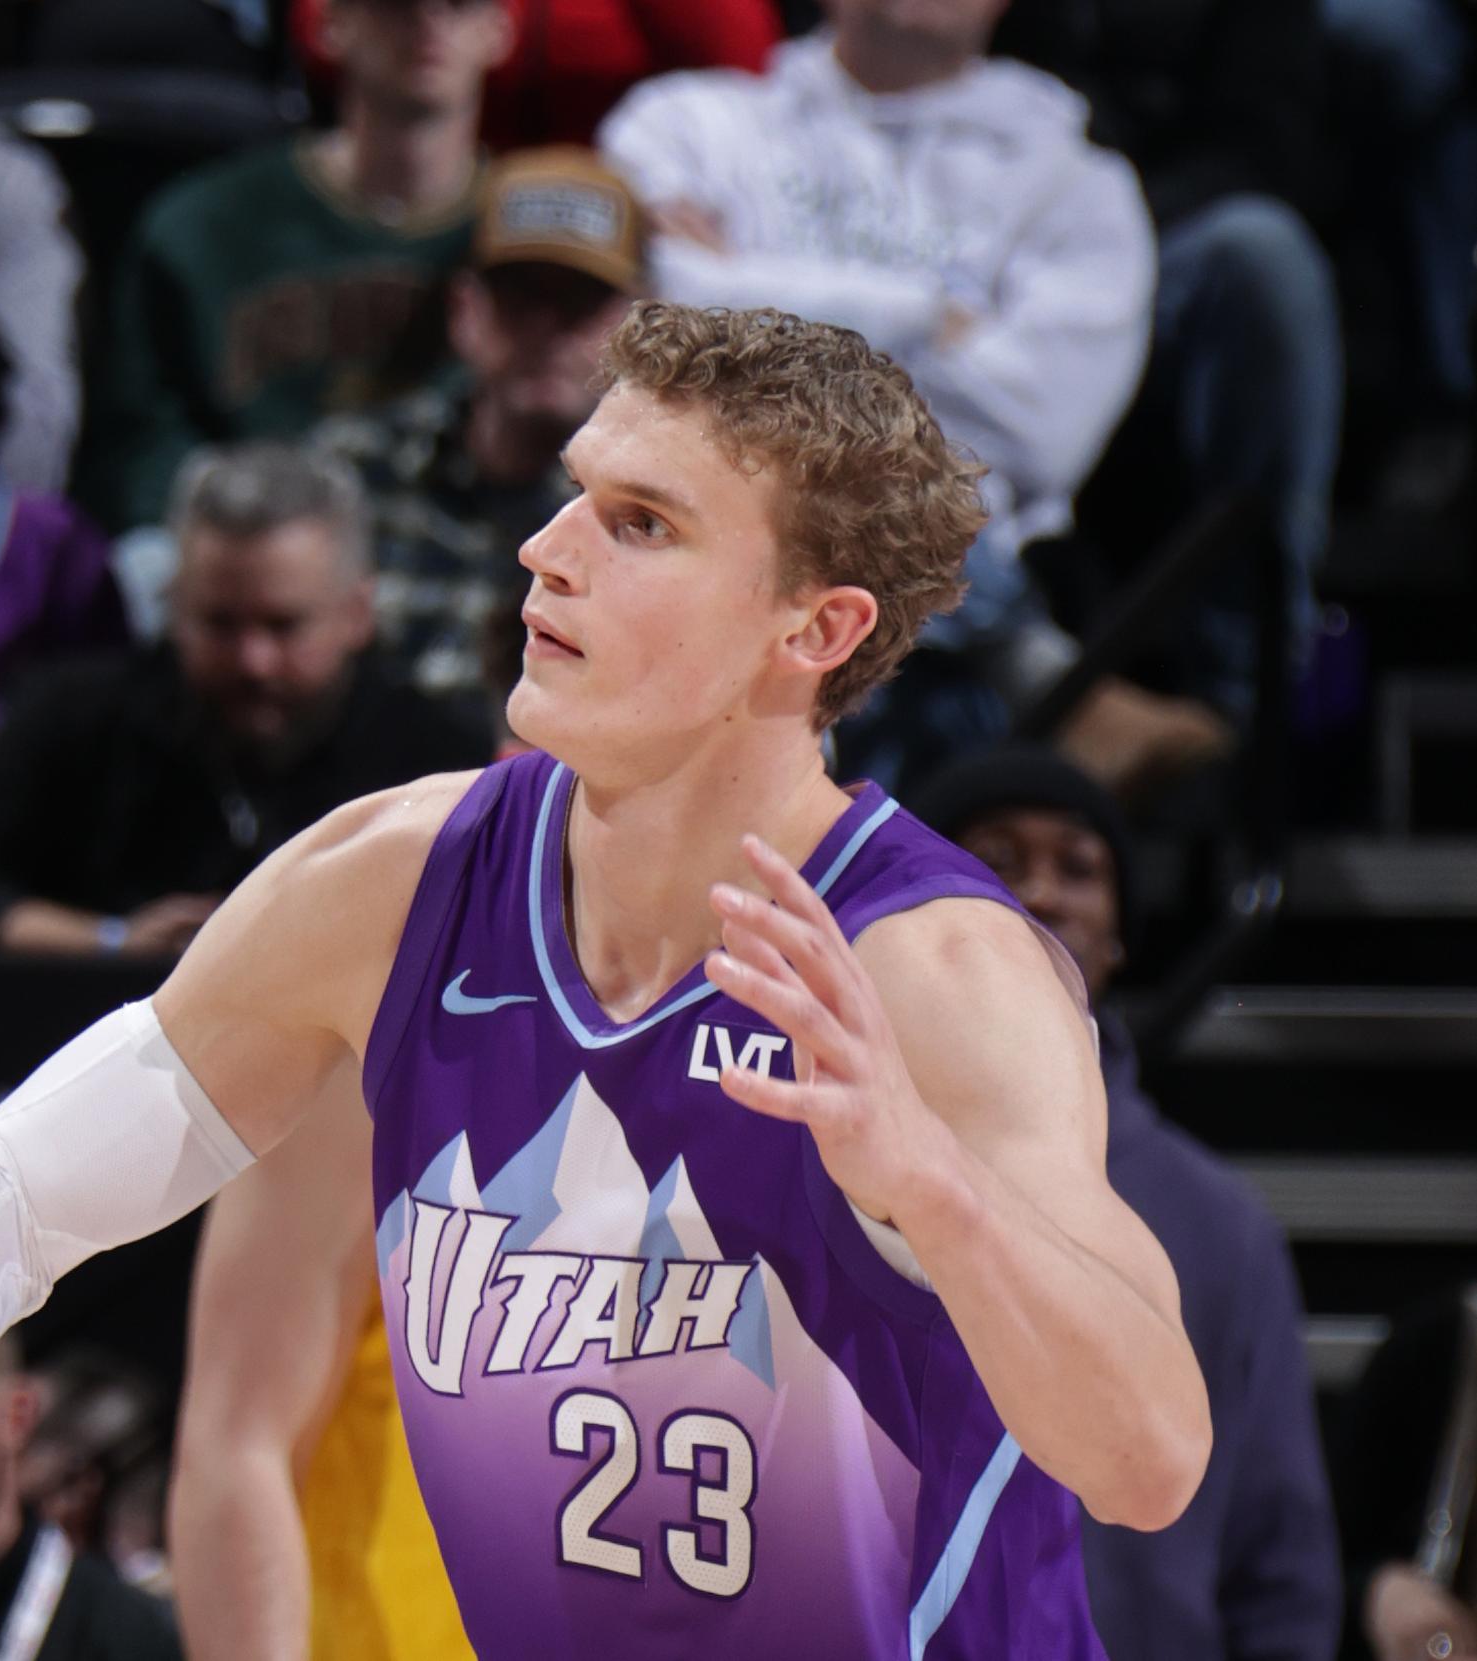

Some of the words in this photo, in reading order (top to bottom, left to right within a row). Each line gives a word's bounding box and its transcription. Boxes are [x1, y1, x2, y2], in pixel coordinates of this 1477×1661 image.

[688, 1023, 788, 1083] LVT
[404, 1196, 757, 1396] UTAH
[550, 1387, 759, 1600] 23
